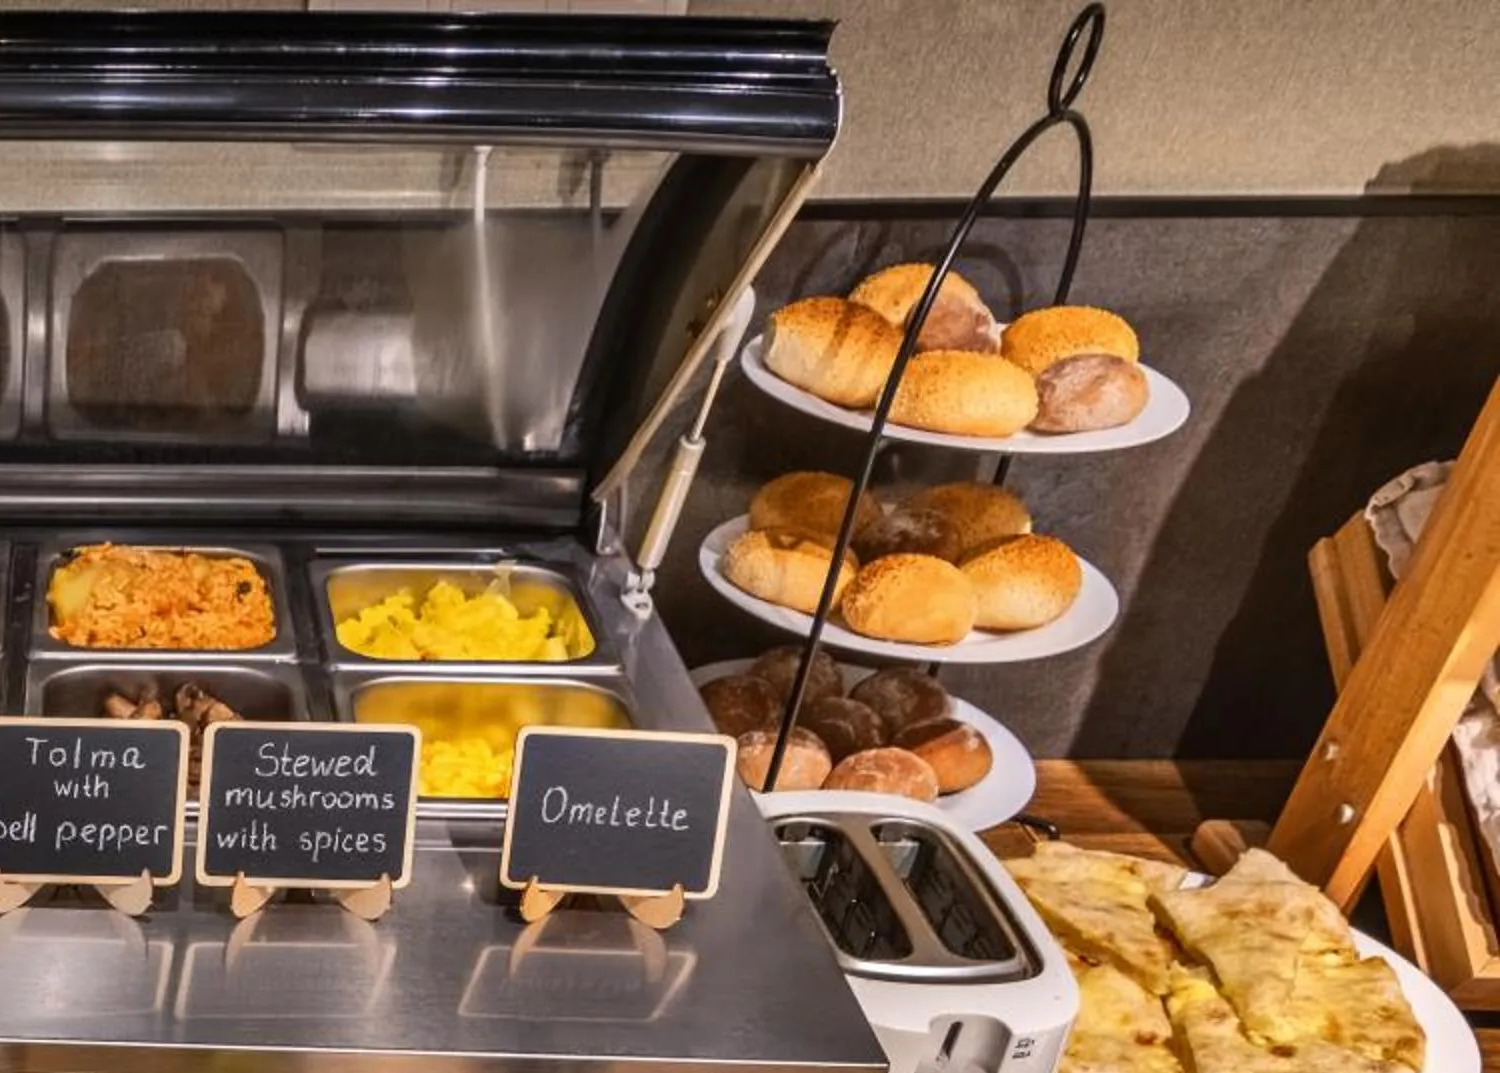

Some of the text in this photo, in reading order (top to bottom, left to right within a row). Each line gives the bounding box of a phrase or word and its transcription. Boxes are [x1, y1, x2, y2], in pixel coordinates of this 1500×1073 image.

[25, 737, 146, 769] Tolma
[255, 742, 378, 777] Stewed
[53, 774, 110, 799] with
[225, 784, 395, 810] mushrooms
[541, 785, 690, 831] Omelette
[55, 821, 169, 851] pepper
[216, 818, 388, 863] with spices
